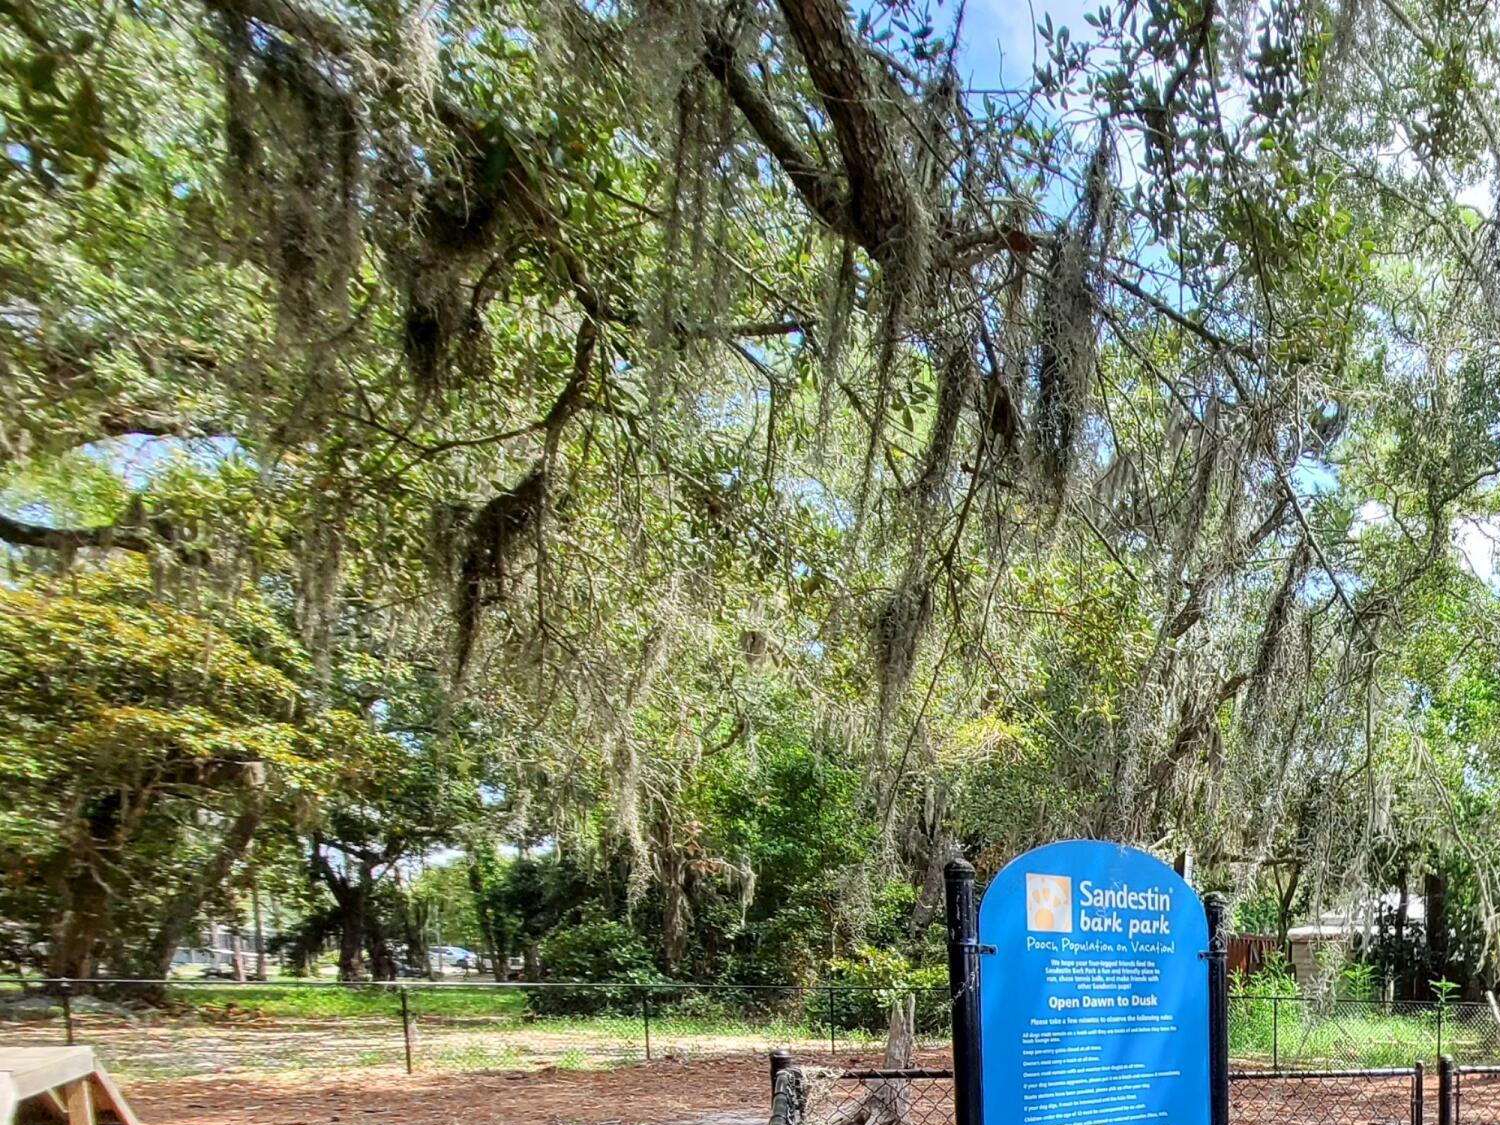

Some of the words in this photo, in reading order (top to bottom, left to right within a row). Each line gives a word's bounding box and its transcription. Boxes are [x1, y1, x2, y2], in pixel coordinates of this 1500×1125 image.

[1079, 880, 1171, 912] Sandestin
[1080, 909, 1123, 933] bark
[1128, 914, 1171, 939] park
[1026, 936, 1058, 952] Pooch
[1061, 937, 1113, 955] Population
[1116, 943, 1128, 952] on
[1131, 940, 1175, 954] Vacation!
[1061, 960, 1074, 968] hope
[1075, 960, 1088, 968] your
[1084, 967, 1097, 975] Park
[1049, 996, 1080, 1011] Open
[1082, 995, 1114, 1008] Dawn
[1117, 996, 1129, 1006] to
[1131, 994, 1158, 1006] Dusk
[1030, 1018, 1048, 1026] Please
[1049, 1017, 1061, 1025] take
